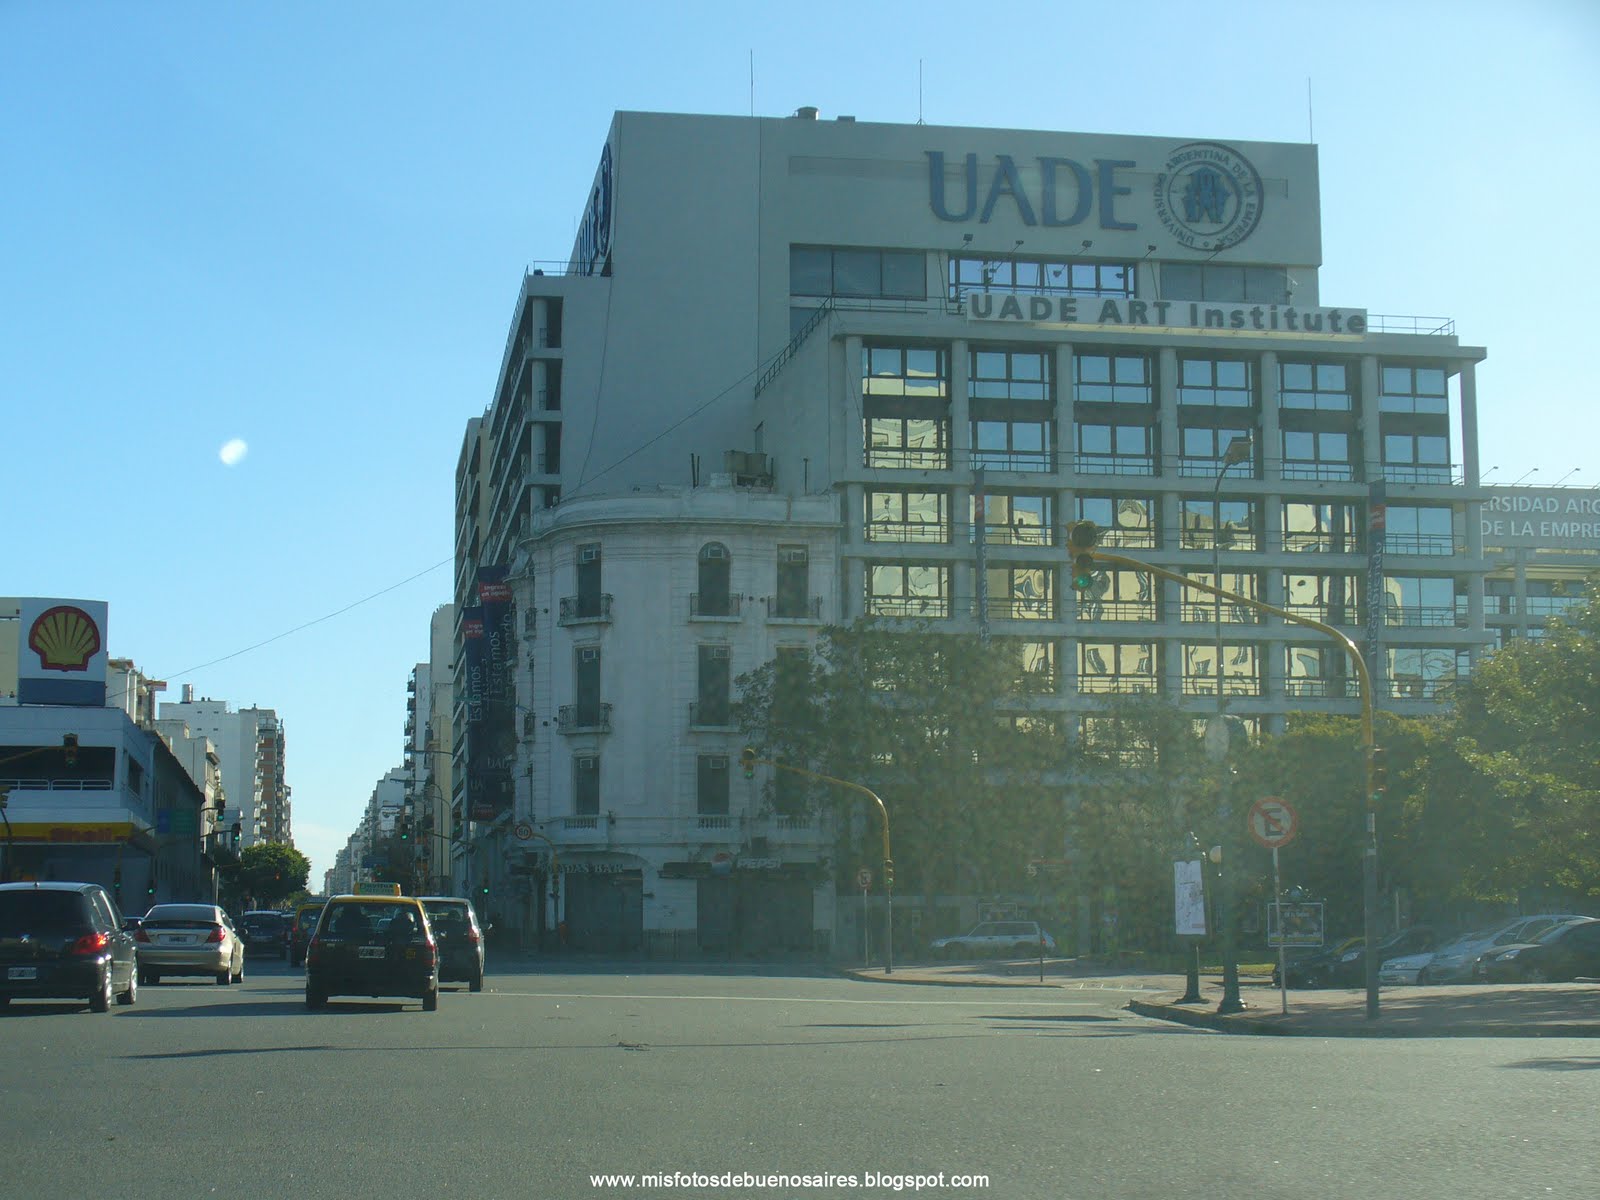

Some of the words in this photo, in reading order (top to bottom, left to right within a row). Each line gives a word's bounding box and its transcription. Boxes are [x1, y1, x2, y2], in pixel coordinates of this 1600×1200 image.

[1166, 149, 1229, 171] ARGENTINA
[925, 150, 1138, 231] UADE
[971, 294, 1078, 323] UADE
[1098, 299, 1171, 327] ART
[1189, 302, 1366, 334] Institute
[1481, 520, 1504, 536] DE
[1511, 520, 1534, 536] LA
[736, 856, 784, 869] PEPSI
